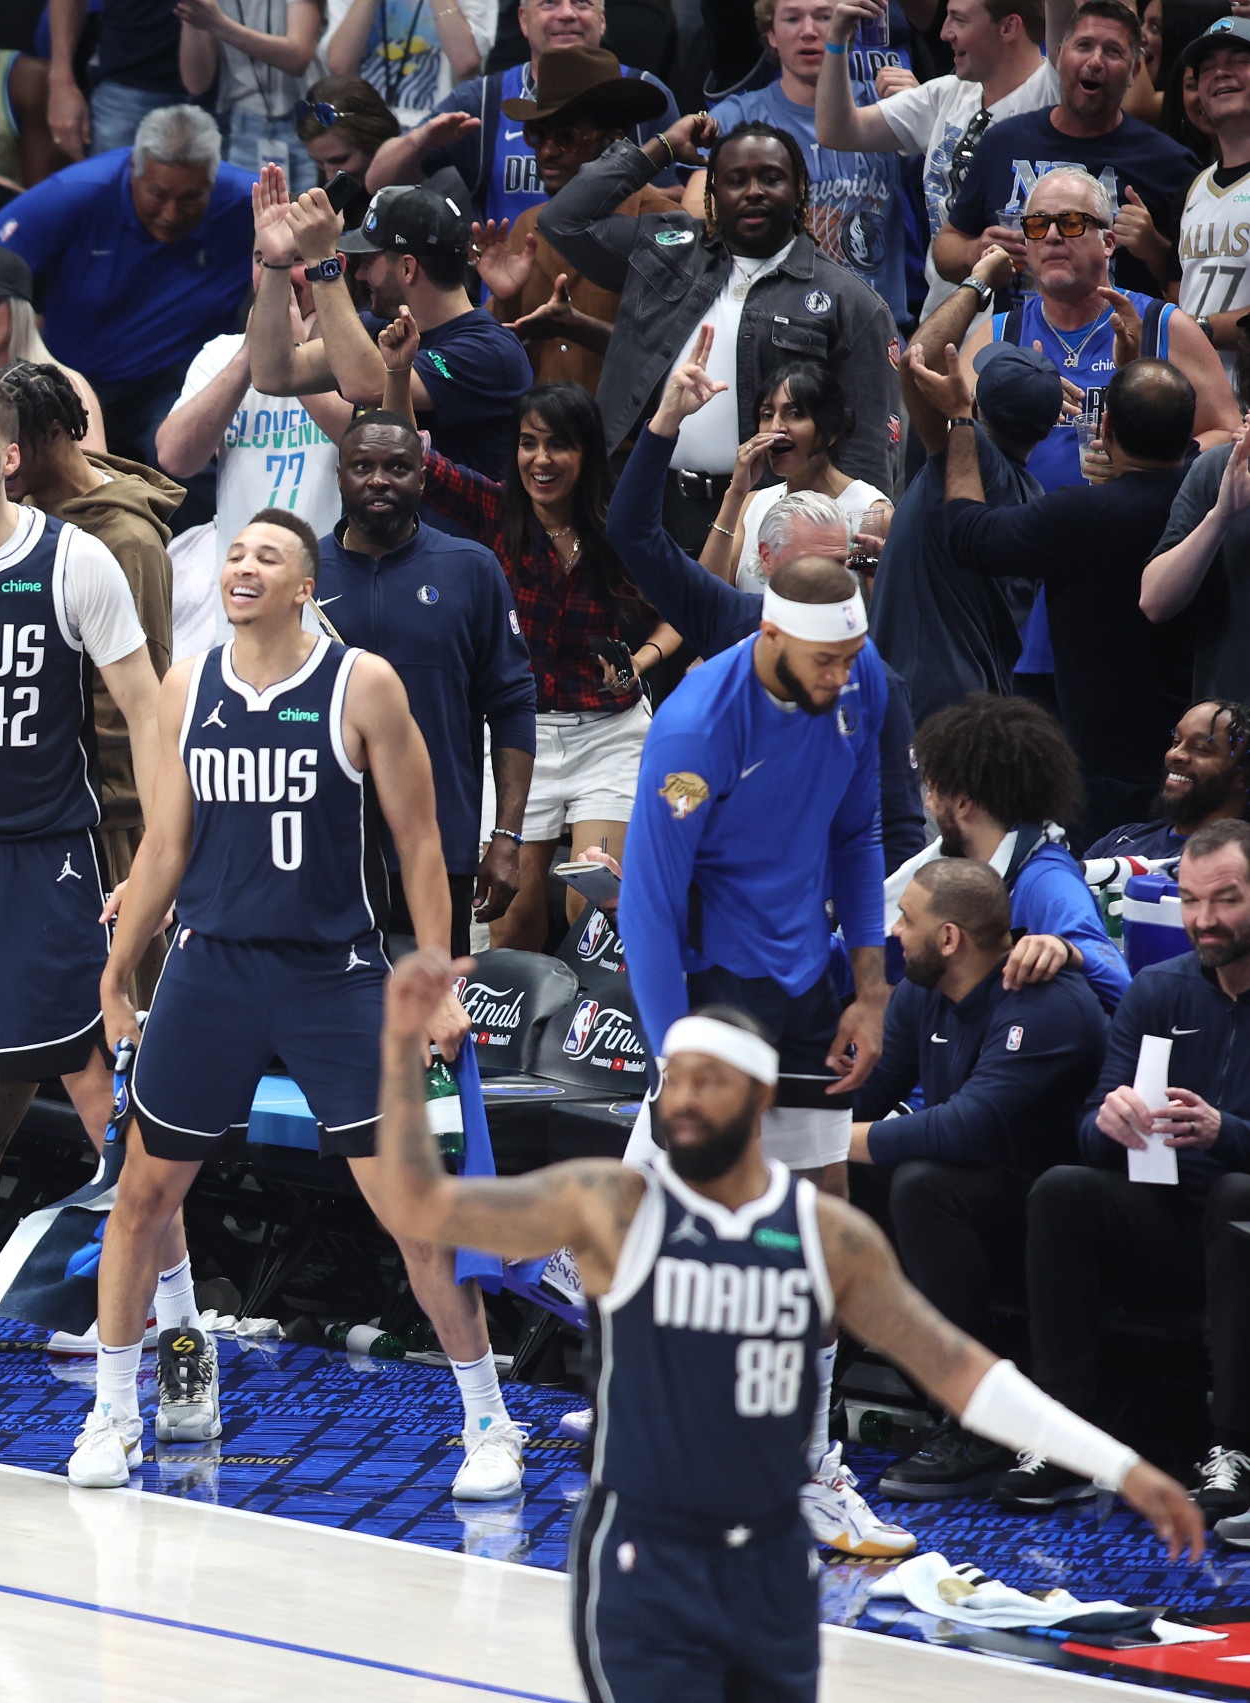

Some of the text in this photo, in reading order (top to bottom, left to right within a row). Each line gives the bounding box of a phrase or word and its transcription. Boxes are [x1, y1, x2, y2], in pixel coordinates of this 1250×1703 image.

[1196, 266, 1247, 316] 77
[266, 451, 305, 510] 77
[1, 579, 42, 593] chime
[277, 707, 320, 722] chime
[189, 747, 318, 803] MAVS
[270, 810, 303, 871] 0
[463, 982, 526, 1028] Finals
[653, 1256, 811, 1338] MAVS
[311, 1372, 374, 1380] MIKE
[319, 1381, 429, 1391] SALAH
[734, 1339, 806, 1418] 88
[220, 1391, 349, 1402] DETLEF
[245, 1406, 428, 1418] NIMPHIUS
[934, 1516, 1095, 1530] TARPLEY
